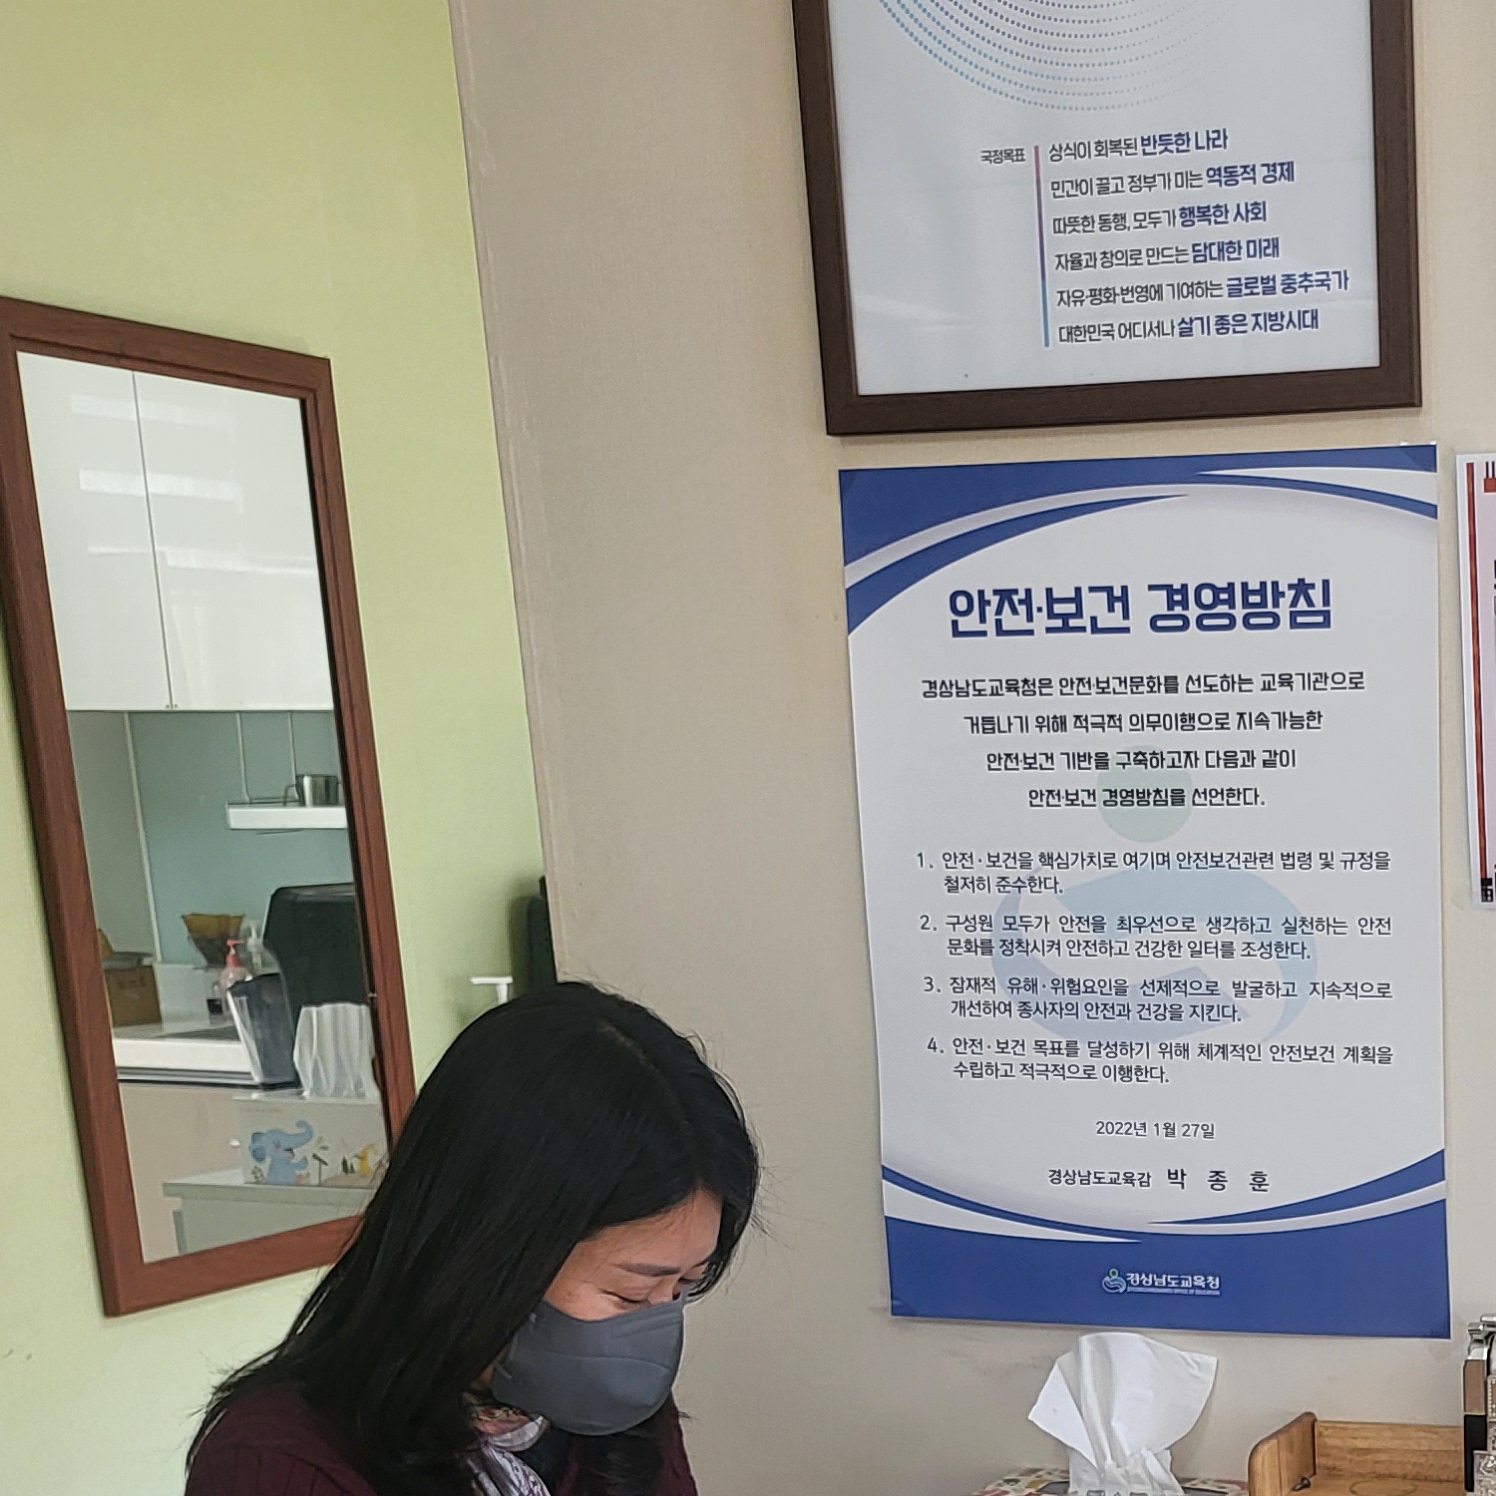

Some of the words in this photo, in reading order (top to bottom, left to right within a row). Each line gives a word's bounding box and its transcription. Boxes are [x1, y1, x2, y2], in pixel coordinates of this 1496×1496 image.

[1049, 141, 1091, 162] 상식이
[1094, 138, 1137, 157] 회복된
[1141, 132, 1191, 156] 반듯한
[1195, 128, 1228, 150] 나라
[1051, 178, 1093, 198] 민간이
[1096, 177, 1125, 195] 끌고
[1128, 173, 1171, 192] 정부가
[1175, 171, 1203, 188] 미는
[1206, 164, 1256, 187] 역동적
[1261, 161, 1294, 183] 경제
[1053, 215, 1095, 234] 따뜻한
[1098, 213, 1130, 232] 동행,
[1133, 209, 1176, 229] 모두가
[1179, 204, 1229, 227] 행복한
[1234, 201, 1266, 222] 사회
[1055, 252, 1097, 271] 자율과
[1100, 249, 1143, 268] 창의로
[1146, 246, 1189, 265] 만드는
[1192, 240, 1242, 263] 담대한
[1247, 237, 1279, 259] 미래
[1166, 281, 1223, 300] 기여하는
[1227, 275, 1276, 297] 글로벌
[1281, 270, 1349, 294] 중추국가
[1059, 323, 1115, 342] 대한민국
[1118, 320, 1175, 339] 어디서나
[1178, 316, 1210, 337] 살기
[1215, 314, 1247, 335] 좋은
[1251, 309, 1318, 332] 지방시대
[1148, 578, 1330, 632] 경영방침
[922, 678, 1053, 698] 경상남도교육청은
[1186, 674, 1253, 693] 선도하는
[1261, 672, 1364, 691] 교육기관으로
[1103, 788, 1185, 806] 경영방침을
[1192, 788, 1264, 806] 선언한다.
[1096, 1121, 1147, 1136] 2022년
[1154, 1123, 1175, 1137] 1월
[1182, 1124, 1214, 1139] 27일
[1049, 1169, 1151, 1187] 경상남도교육감
[1168, 1169, 1186, 1189] 박
[1208, 1171, 1227, 1191] 종
[1249, 1171, 1269, 1192] 훈
